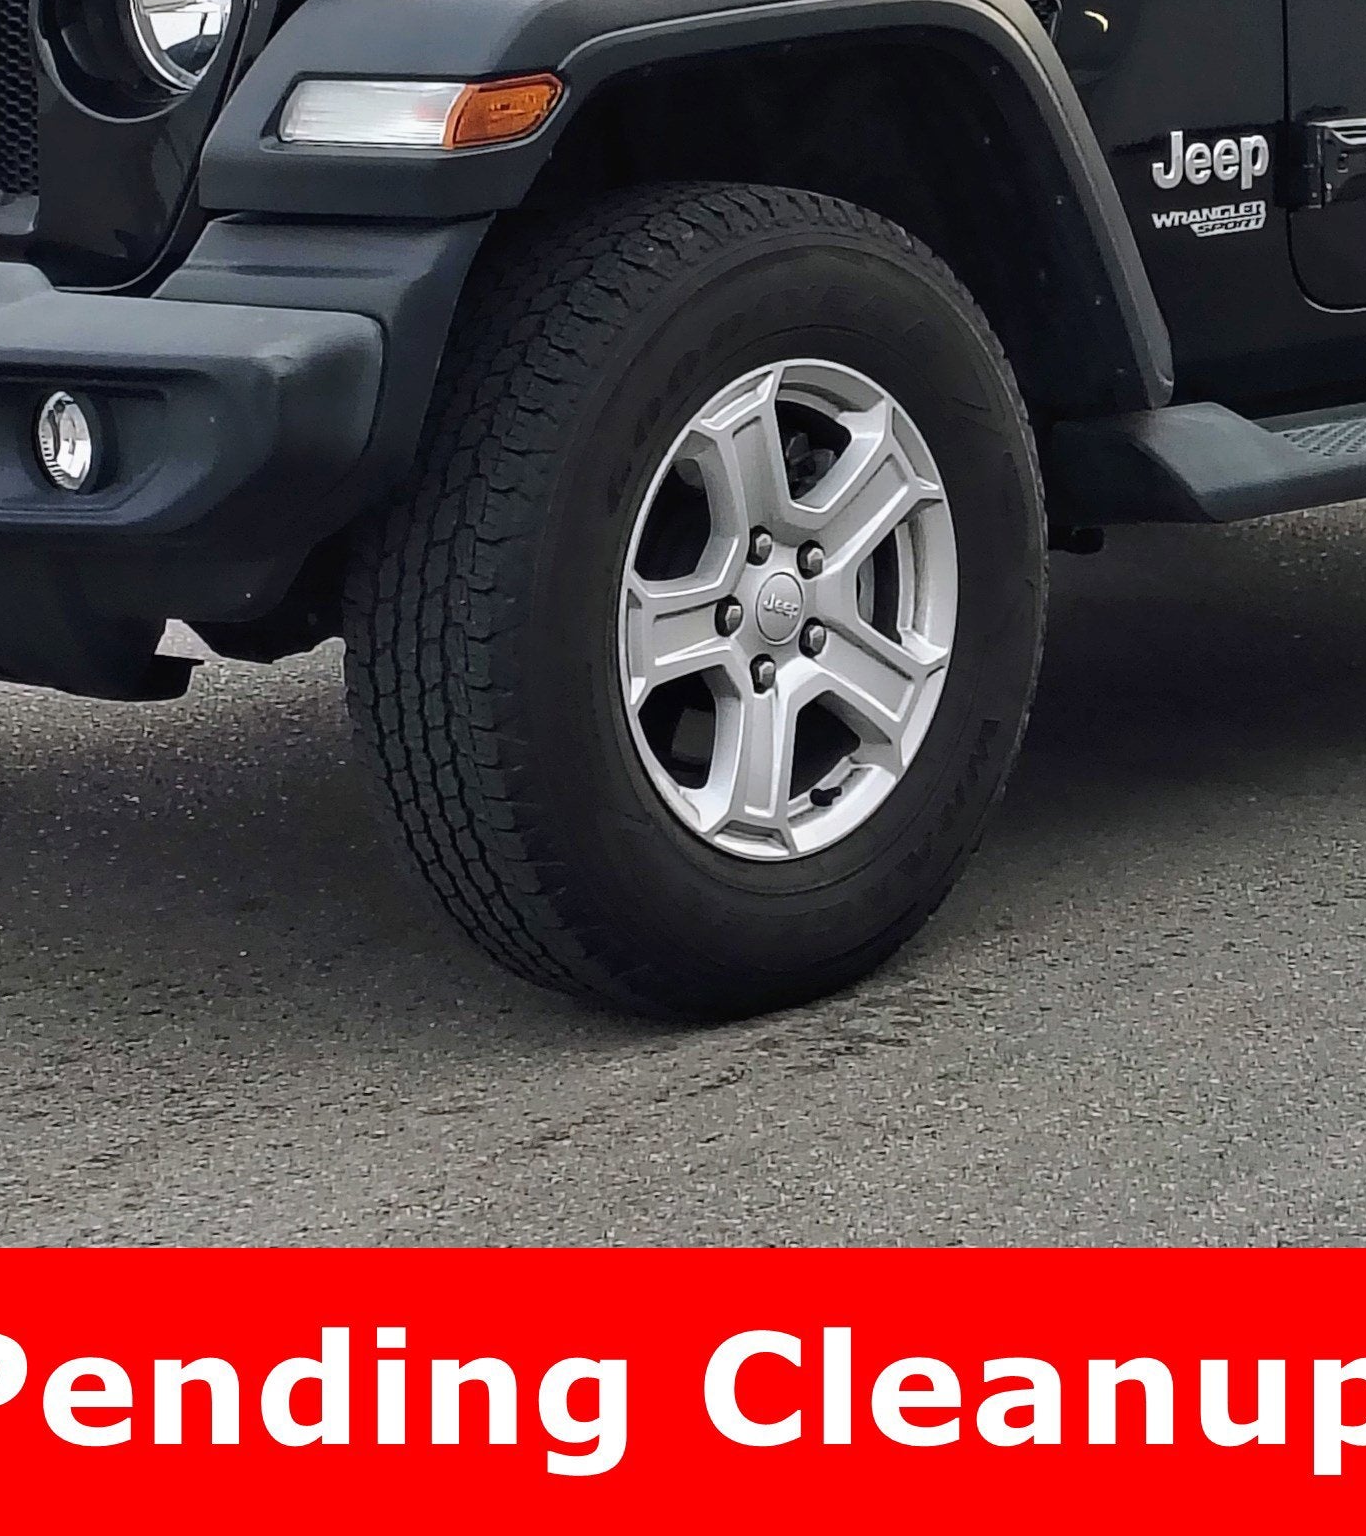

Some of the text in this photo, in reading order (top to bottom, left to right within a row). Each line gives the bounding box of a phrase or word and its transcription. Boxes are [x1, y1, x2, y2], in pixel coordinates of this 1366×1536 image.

[1151, 130, 1270, 190] Jeep
[1151, 199, 1267, 229] WRANGLER
[1194, 216, 1264, 235] SPORT
[763, 593, 799, 619] Jeep
